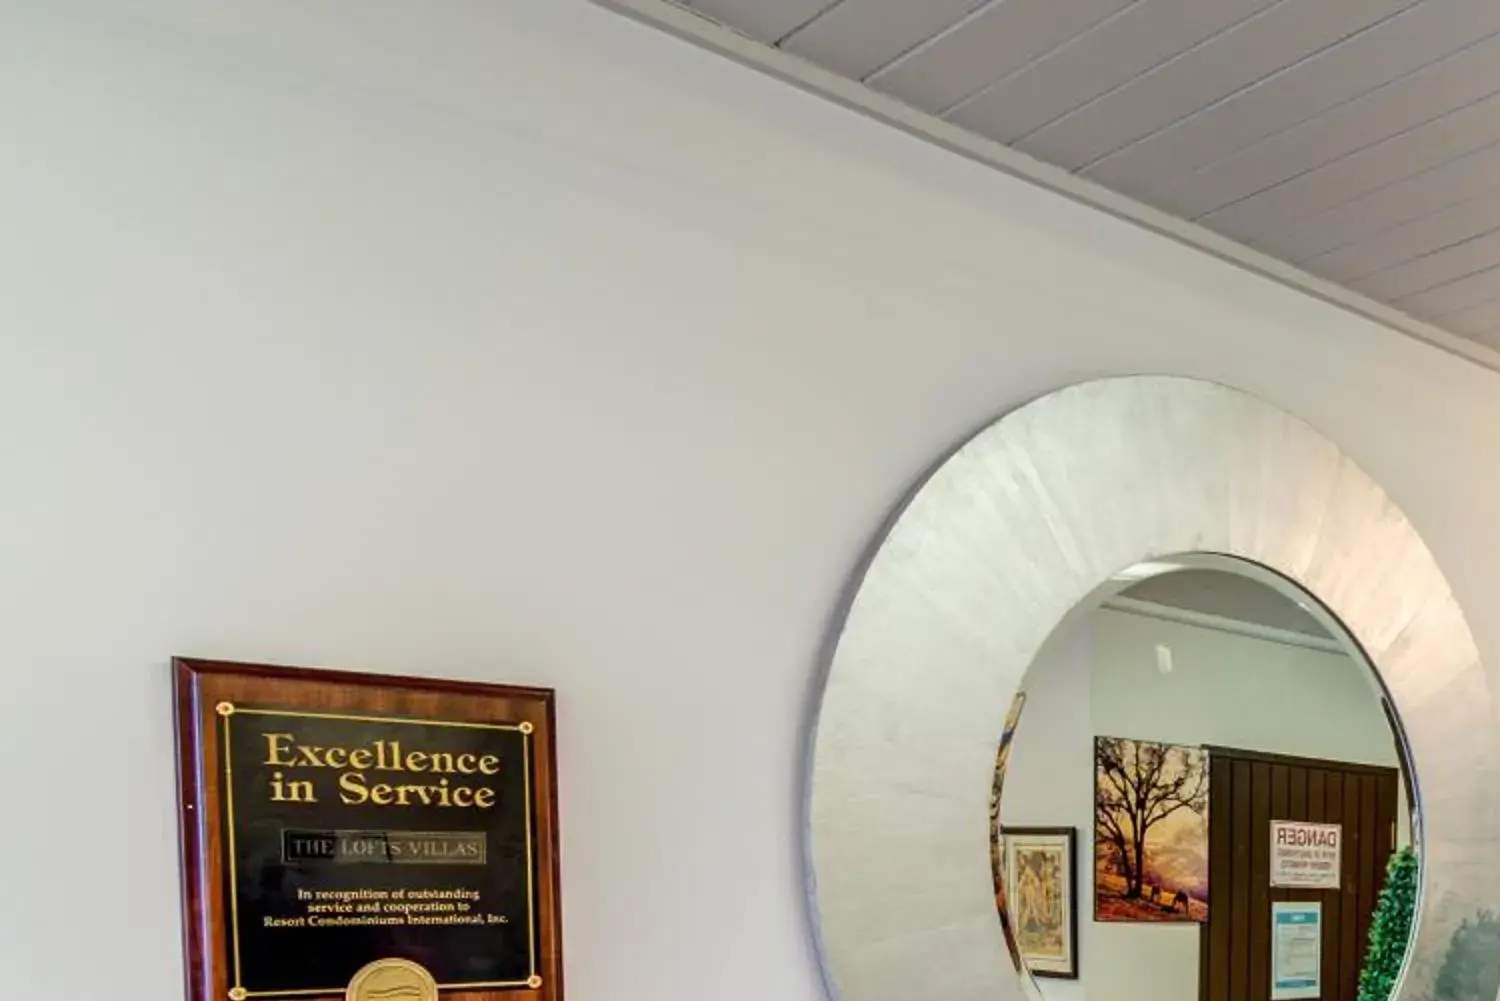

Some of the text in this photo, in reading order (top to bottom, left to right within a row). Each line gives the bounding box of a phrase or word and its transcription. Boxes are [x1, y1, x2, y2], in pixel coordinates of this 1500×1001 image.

[262, 732, 500, 775] Excellence
[270, 771, 497, 808] in Service
[293, 838, 479, 857] THE LOFTS VILLAS
[297, 888, 480, 903] In recognition of outstanding
[307, 901, 471, 916] service and cooperation to
[263, 912, 509, 928] Resort Condominiums International, Inc.
